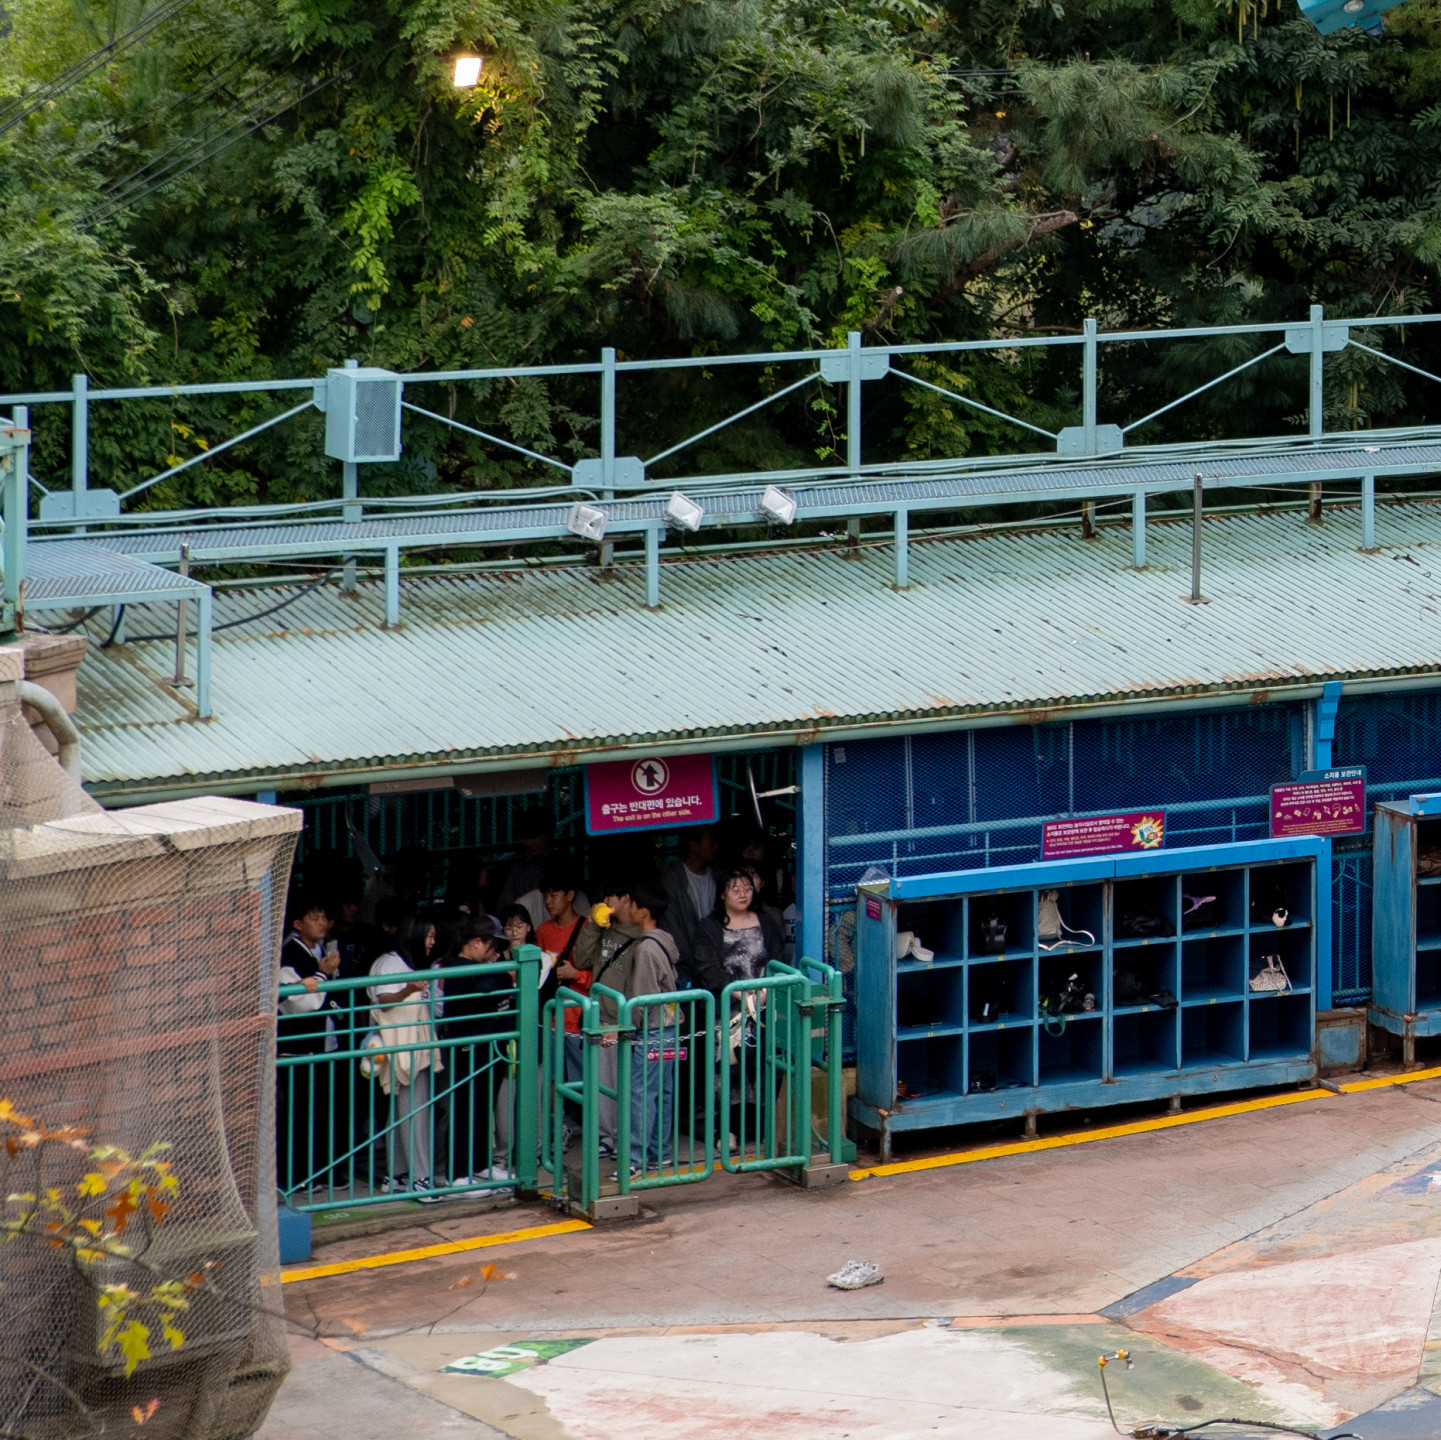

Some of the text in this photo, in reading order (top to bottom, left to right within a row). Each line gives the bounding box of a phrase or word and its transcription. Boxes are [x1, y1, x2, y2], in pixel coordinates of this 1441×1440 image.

[601, 795, 702, 815] 출구는 반대편에 있습니다.
[612, 815, 624, 823] The
[625, 814, 636, 822] exit
[662, 810, 677, 818] other
[678, 809, 692, 817] side.
